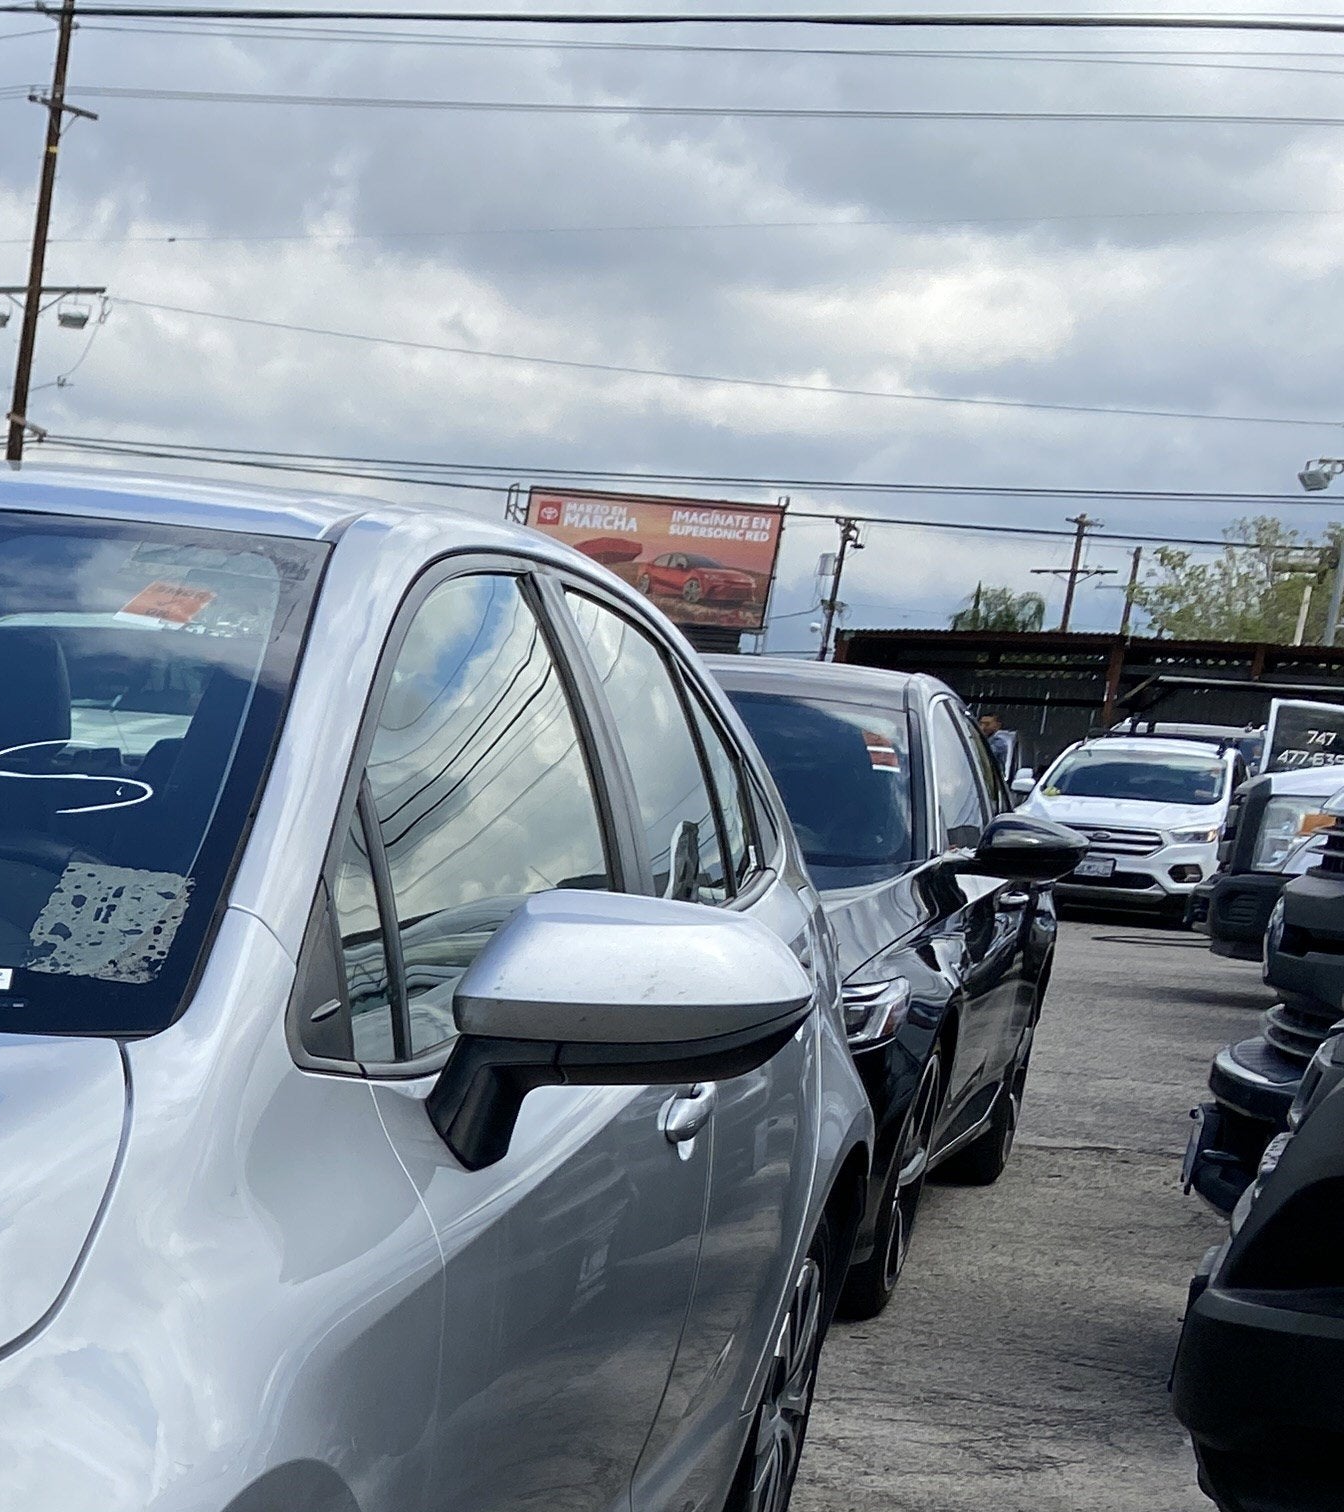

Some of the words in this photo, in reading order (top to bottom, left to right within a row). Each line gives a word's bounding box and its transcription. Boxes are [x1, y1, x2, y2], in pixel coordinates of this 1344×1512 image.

[566, 502, 609, 514] MARZO
[611, 506, 627, 516] EN
[563, 512, 637, 532] MARCHA
[752, 517, 772, 530] EN
[669, 524, 745, 540] SUPERSONIC
[745, 530, 769, 542] RED
[1307, 730, 1337, 746] 747
